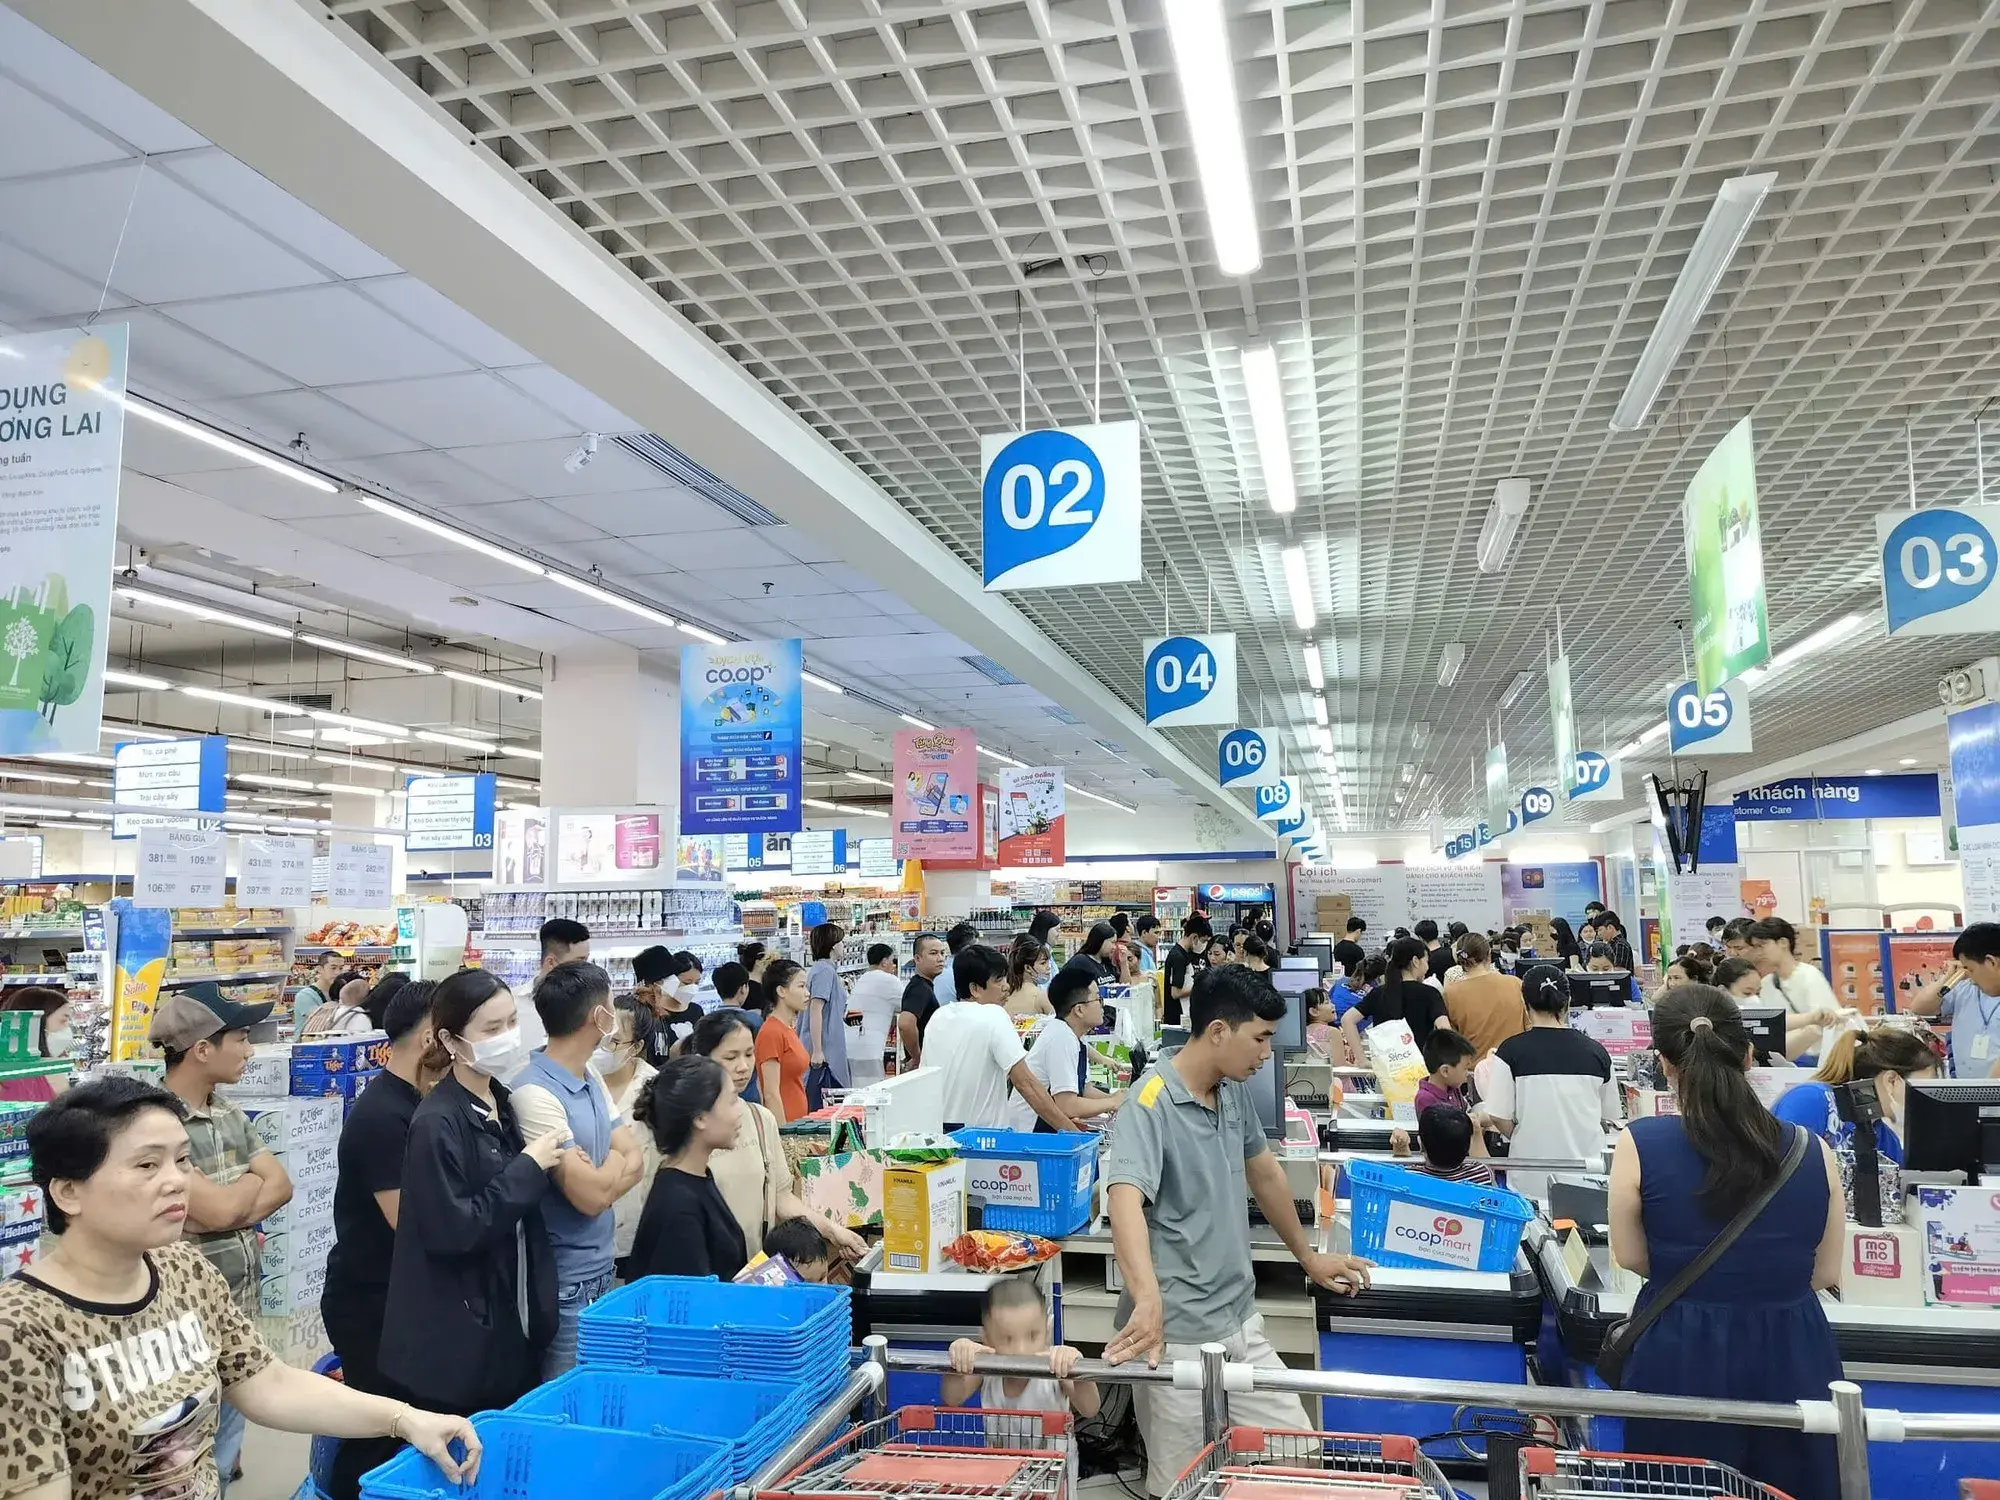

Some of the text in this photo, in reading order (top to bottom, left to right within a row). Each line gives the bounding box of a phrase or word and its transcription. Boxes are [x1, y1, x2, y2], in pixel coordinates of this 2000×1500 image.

[62, 411, 101, 436] LAI
[1001, 459, 1093, 531] 02
[1901, 533, 1988, 589] 03
[1155, 653, 1213, 694] 04
[1678, 692, 1728, 728] 05
[1226, 740, 1263, 766] 06
[1576, 759, 1606, 784] 07
[1261, 785, 1288, 805] 08
[1748, 783, 1860, 802] khách hàng
[1525, 794, 1552, 813] 09
[1770, 805, 1792, 814] Care
[475, 833, 492, 847] 03
[766, 831, 791, 851] ăn
[1458, 839, 1472, 849] 15
[148, 853, 178, 863] 381.
[749, 857, 761, 867] 05
[834, 864, 846, 873] 06
[1231, 885, 1263, 899] pepsi
[367, 1041, 392, 1067] Tige
[244, 1060, 263, 1074] iger
[323, 1059, 345, 1073] Tiger
[240, 1075, 270, 1085] YSTAL
[307, 1106, 324, 1121] Tiger
[291, 1121, 328, 1137] CRYSTAL
[258, 1131, 279, 1145] Tiger
[315, 1146, 332, 1161] Tiger
[299, 1160, 337, 1178] CRYSTAL
[315, 1185, 333, 1200] Tiger
[298, 1203, 332, 1219] CRYSTA
[4, 1222, 42, 1239] Heinek
[314, 1224, 332, 1240] Tiger
[263, 1254, 285, 1268] Tiger
[313, 1265, 327, 1281] Tig
[297, 1280, 326, 1300] CRYST
[263, 1297, 285, 1310] Tiger
[288, 1313, 326, 1350] Tige
